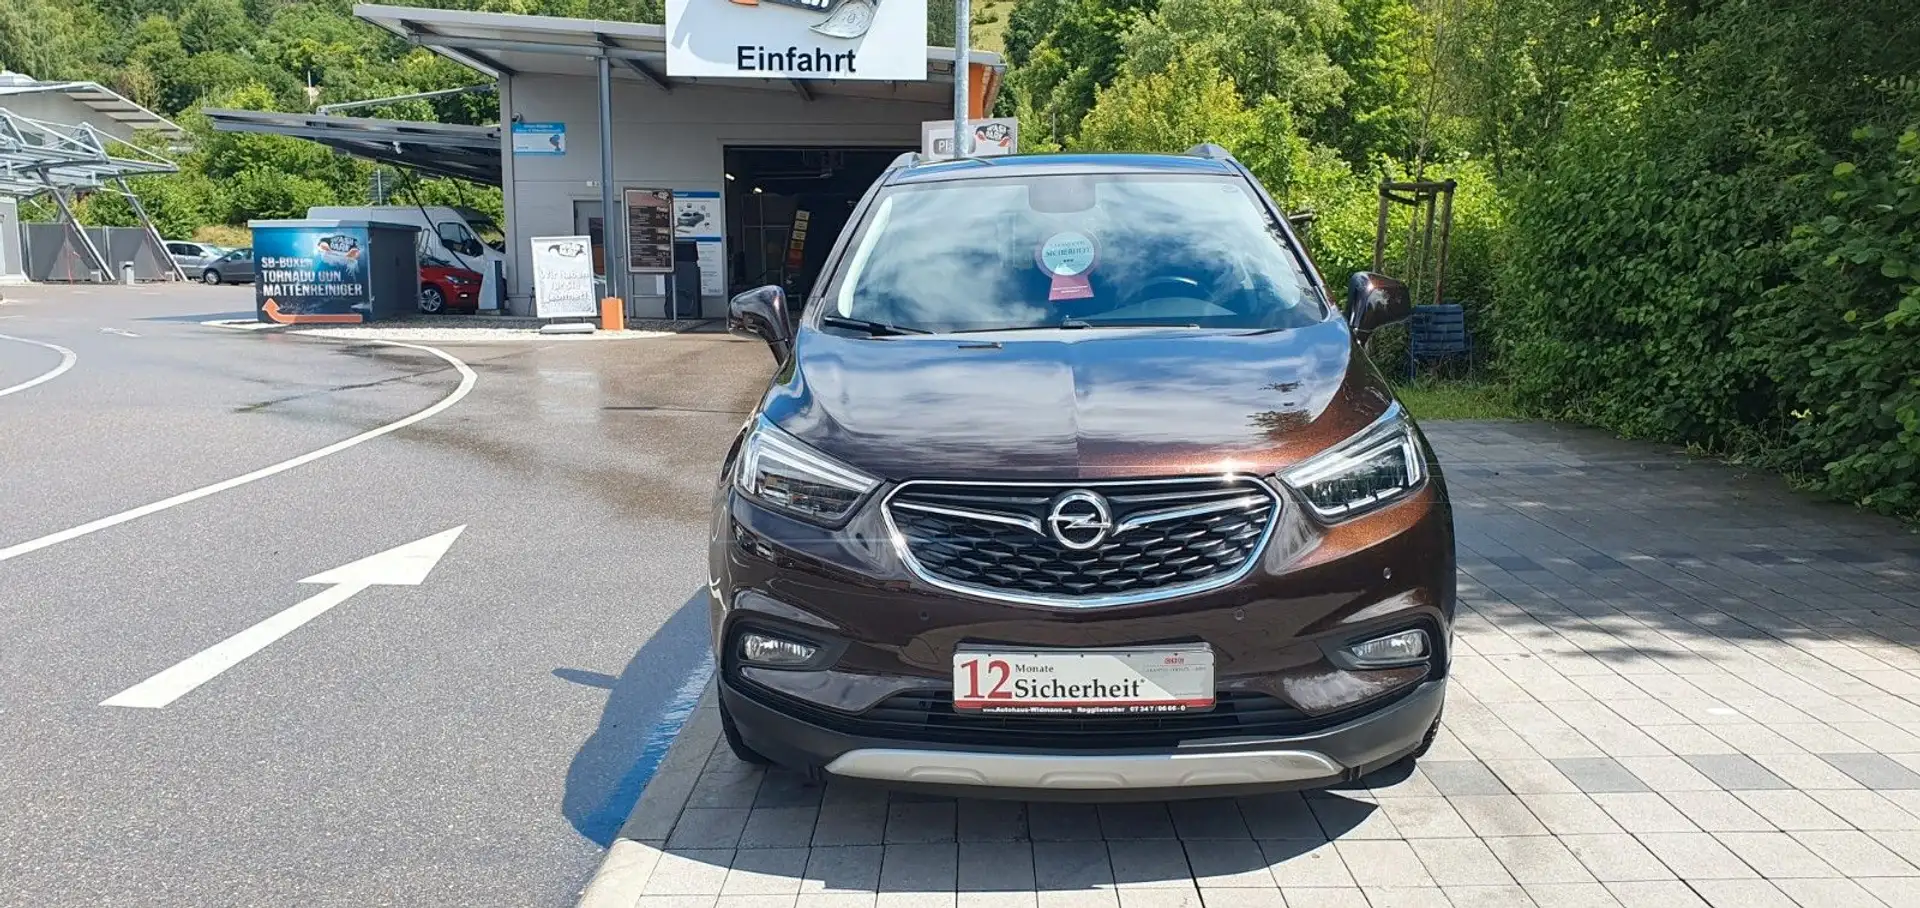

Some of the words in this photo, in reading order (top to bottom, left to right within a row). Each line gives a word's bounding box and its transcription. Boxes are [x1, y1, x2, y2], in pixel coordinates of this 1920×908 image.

[737, 45, 856, 72] Einfahrt
[261, 256, 314, 269] SB-BOXEN
[262, 270, 315, 283] TORNADO
[262, 283, 363, 297] MATTENREINIGER
[1015, 664, 1054, 673] Monate
[960, 659, 1013, 699] 12
